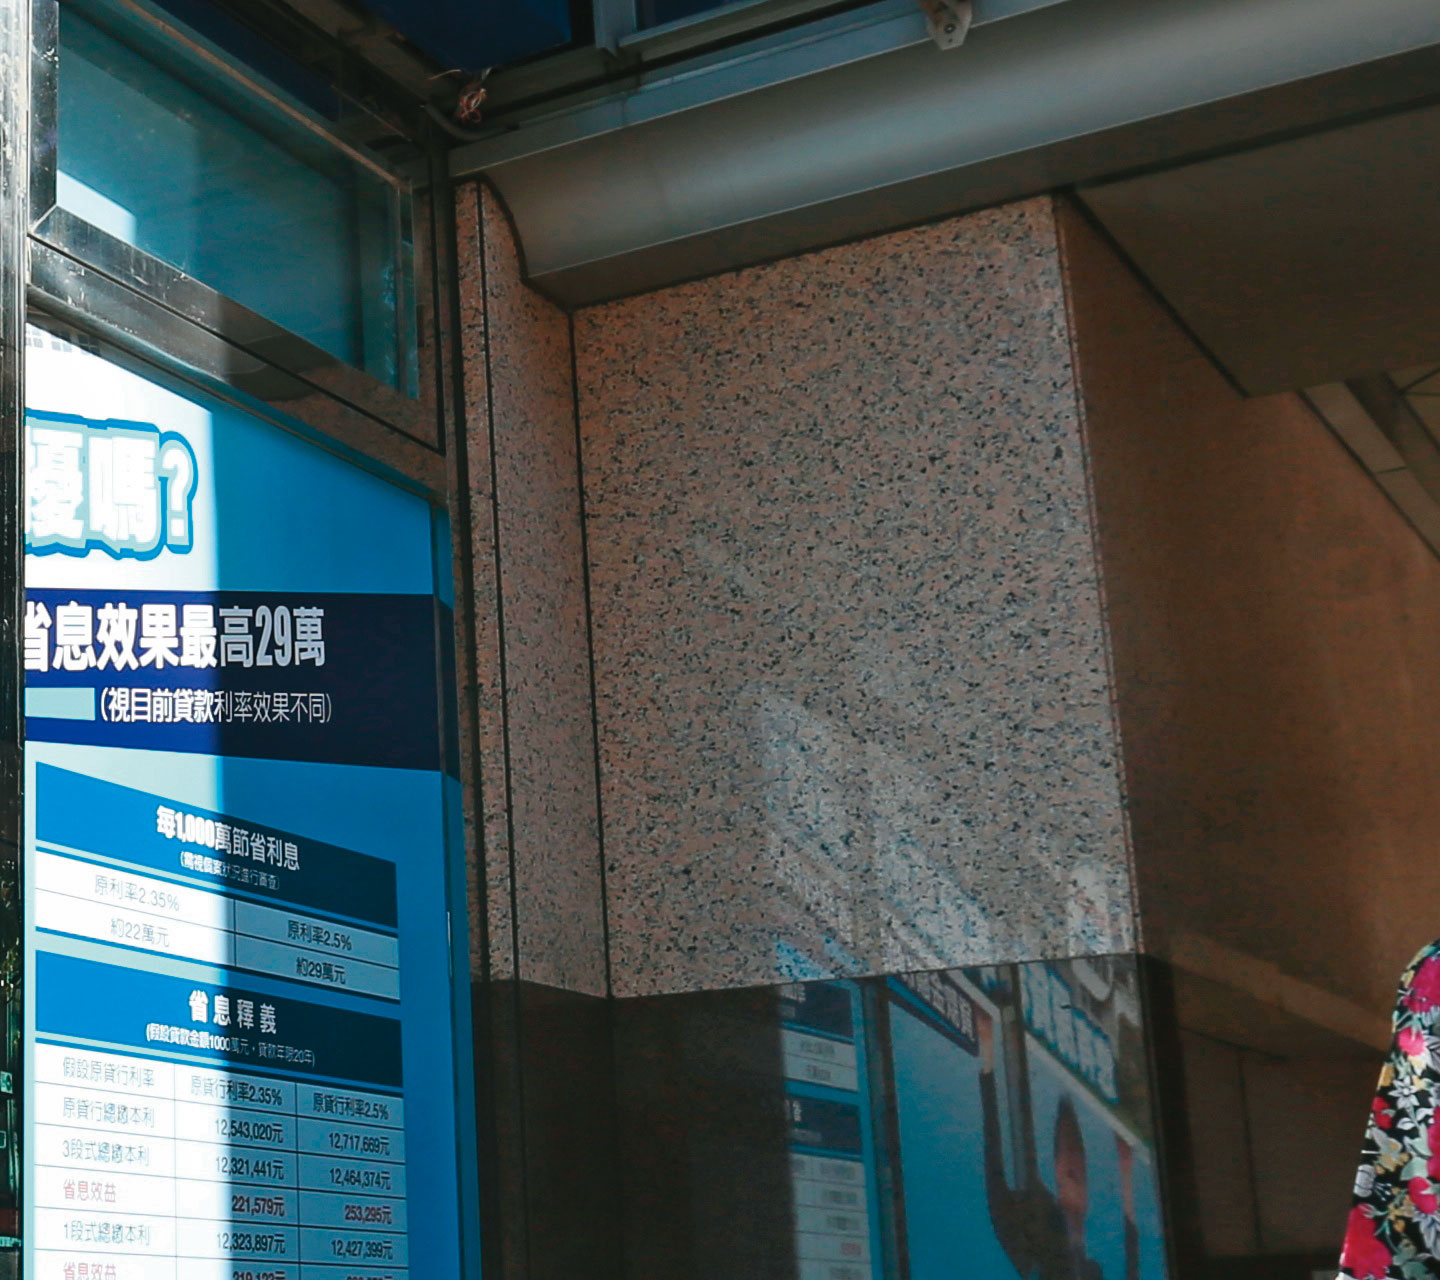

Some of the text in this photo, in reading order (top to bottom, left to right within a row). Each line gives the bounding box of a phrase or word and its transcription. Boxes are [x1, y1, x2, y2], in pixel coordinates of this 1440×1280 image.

[100, 686, 332, 723] (視目前貸款利率效果不同)
[156, 805, 300, 871] 每1,000萬節省利息
[94, 874, 180, 911] 原利率2.35%
[110, 918, 171, 947] 約22萬元
[287, 920, 352, 951] 原利率2.5%
[296, 957, 346, 984] 約29萬元
[191, 1075, 282, 1106] 原貸行利率2.35%
[313, 1092, 389, 1120] 原貸行利率2.5%
[215, 1119, 283, 1143] 12,543,020元
[328, 1133, 390, 1155] 12,717,669元
[215, 1156, 284, 1180] 12,321,441元
[329, 1168, 391, 1190] 12,464,374元
[63, 1178, 117, 1203] 省息效益
[231, 1195, 285, 1217] 221,579元
[344, 1205, 392, 1224] 253,295元
[216, 1233, 286, 1254] 12,323,897元
[331, 1239, 393, 1260] 12,427,399元
